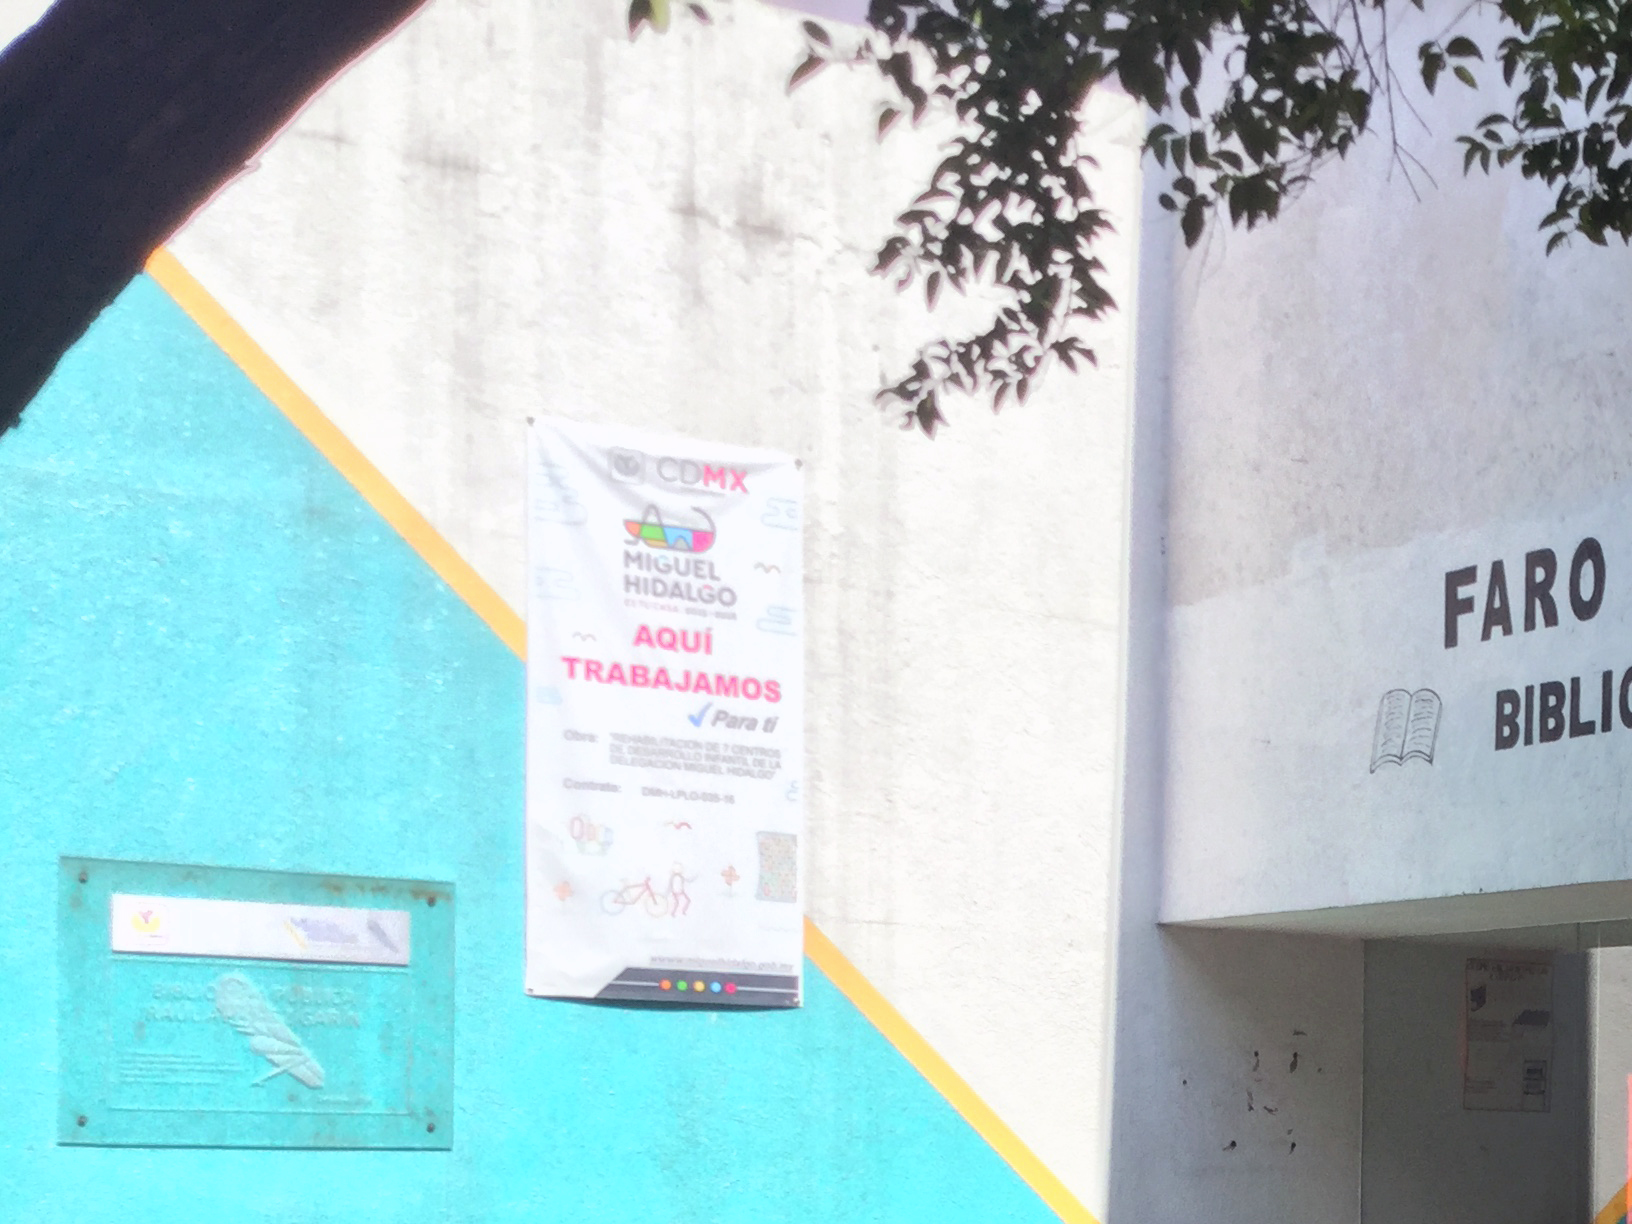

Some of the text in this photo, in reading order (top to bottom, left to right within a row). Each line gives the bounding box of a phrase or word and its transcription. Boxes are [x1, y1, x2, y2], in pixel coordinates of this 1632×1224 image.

[656, 456, 750, 494] CDMX
[623, 550, 721, 582] MIGUEL
[623, 574, 738, 608] HIDALGO
[1443, 536, 1606, 650] FARO
[632, 624, 714, 656] AQUÍ
[560, 656, 783, 704] TRABAJAMOS
[711, 709, 758, 731] Para
[562, 728, 599, 744] Obra:
[704, 741, 720, 753] DE
[731, 744, 782, 760] CENTROS
[609, 743, 623, 754] DE
[627, 744, 703, 763] DESARROLLO
[752, 757, 767, 769] DE
[769, 759, 782, 770] LA
[684, 761, 724, 775] MIGUEL
[562, 777, 622, 793] Contrato:
